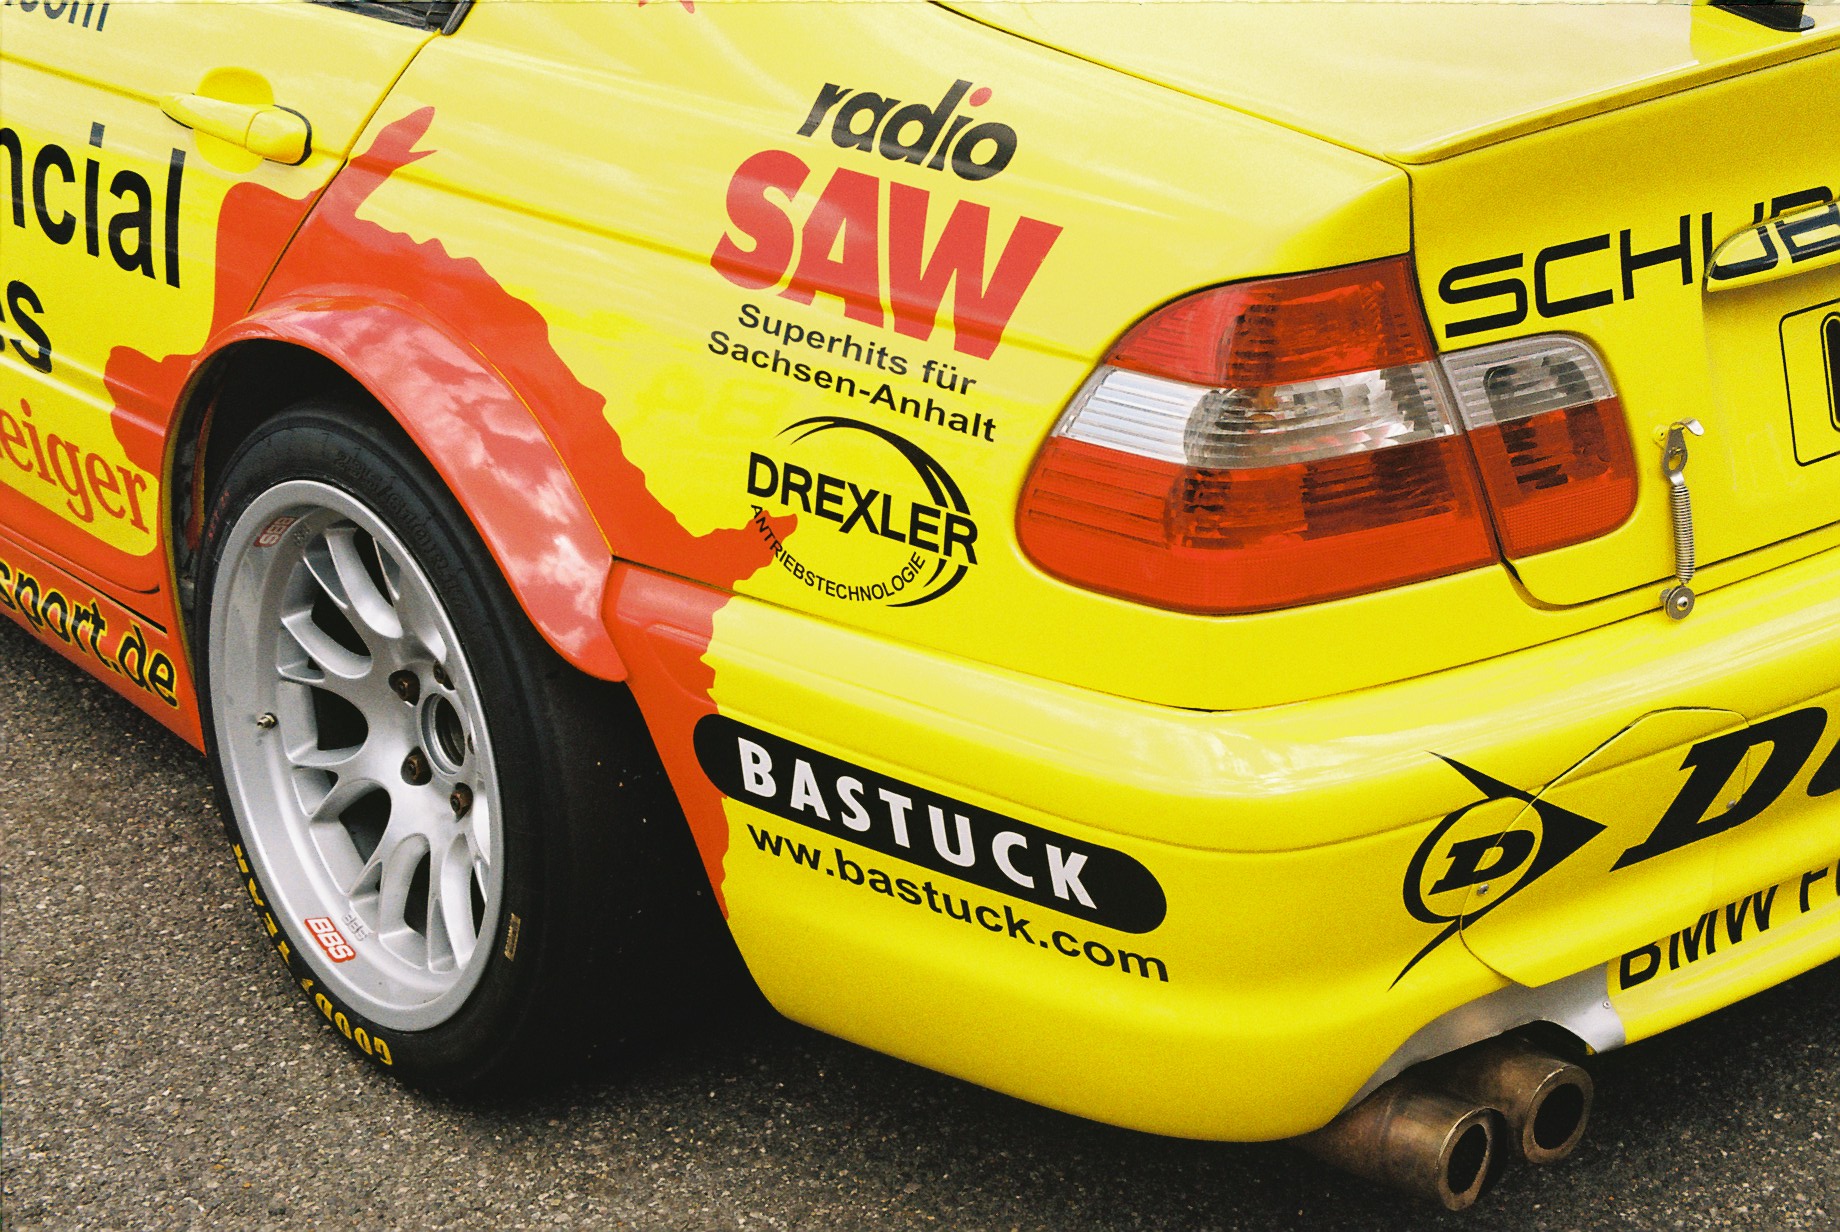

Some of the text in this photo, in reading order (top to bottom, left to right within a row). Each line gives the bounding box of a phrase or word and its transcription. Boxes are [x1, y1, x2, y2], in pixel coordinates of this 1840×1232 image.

[797, 79, 1018, 181] radio
[710, 149, 1064, 361] SAW
[0, 280, 52, 373] s
[738, 303, 977, 395] Superhits für
[707, 330, 996, 442] Sachsen-Anhalt
[0, 398, 149, 534] eiger
[747, 451, 978, 565] DREXLER
[750, 504, 926, 602] ANTRIEBSTECHNOLOGIE
[737, 737, 1098, 910] BASTUCK
[306, 916, 356, 963] BBS
[746, 824, 1169, 983] ww.bastuck.com
